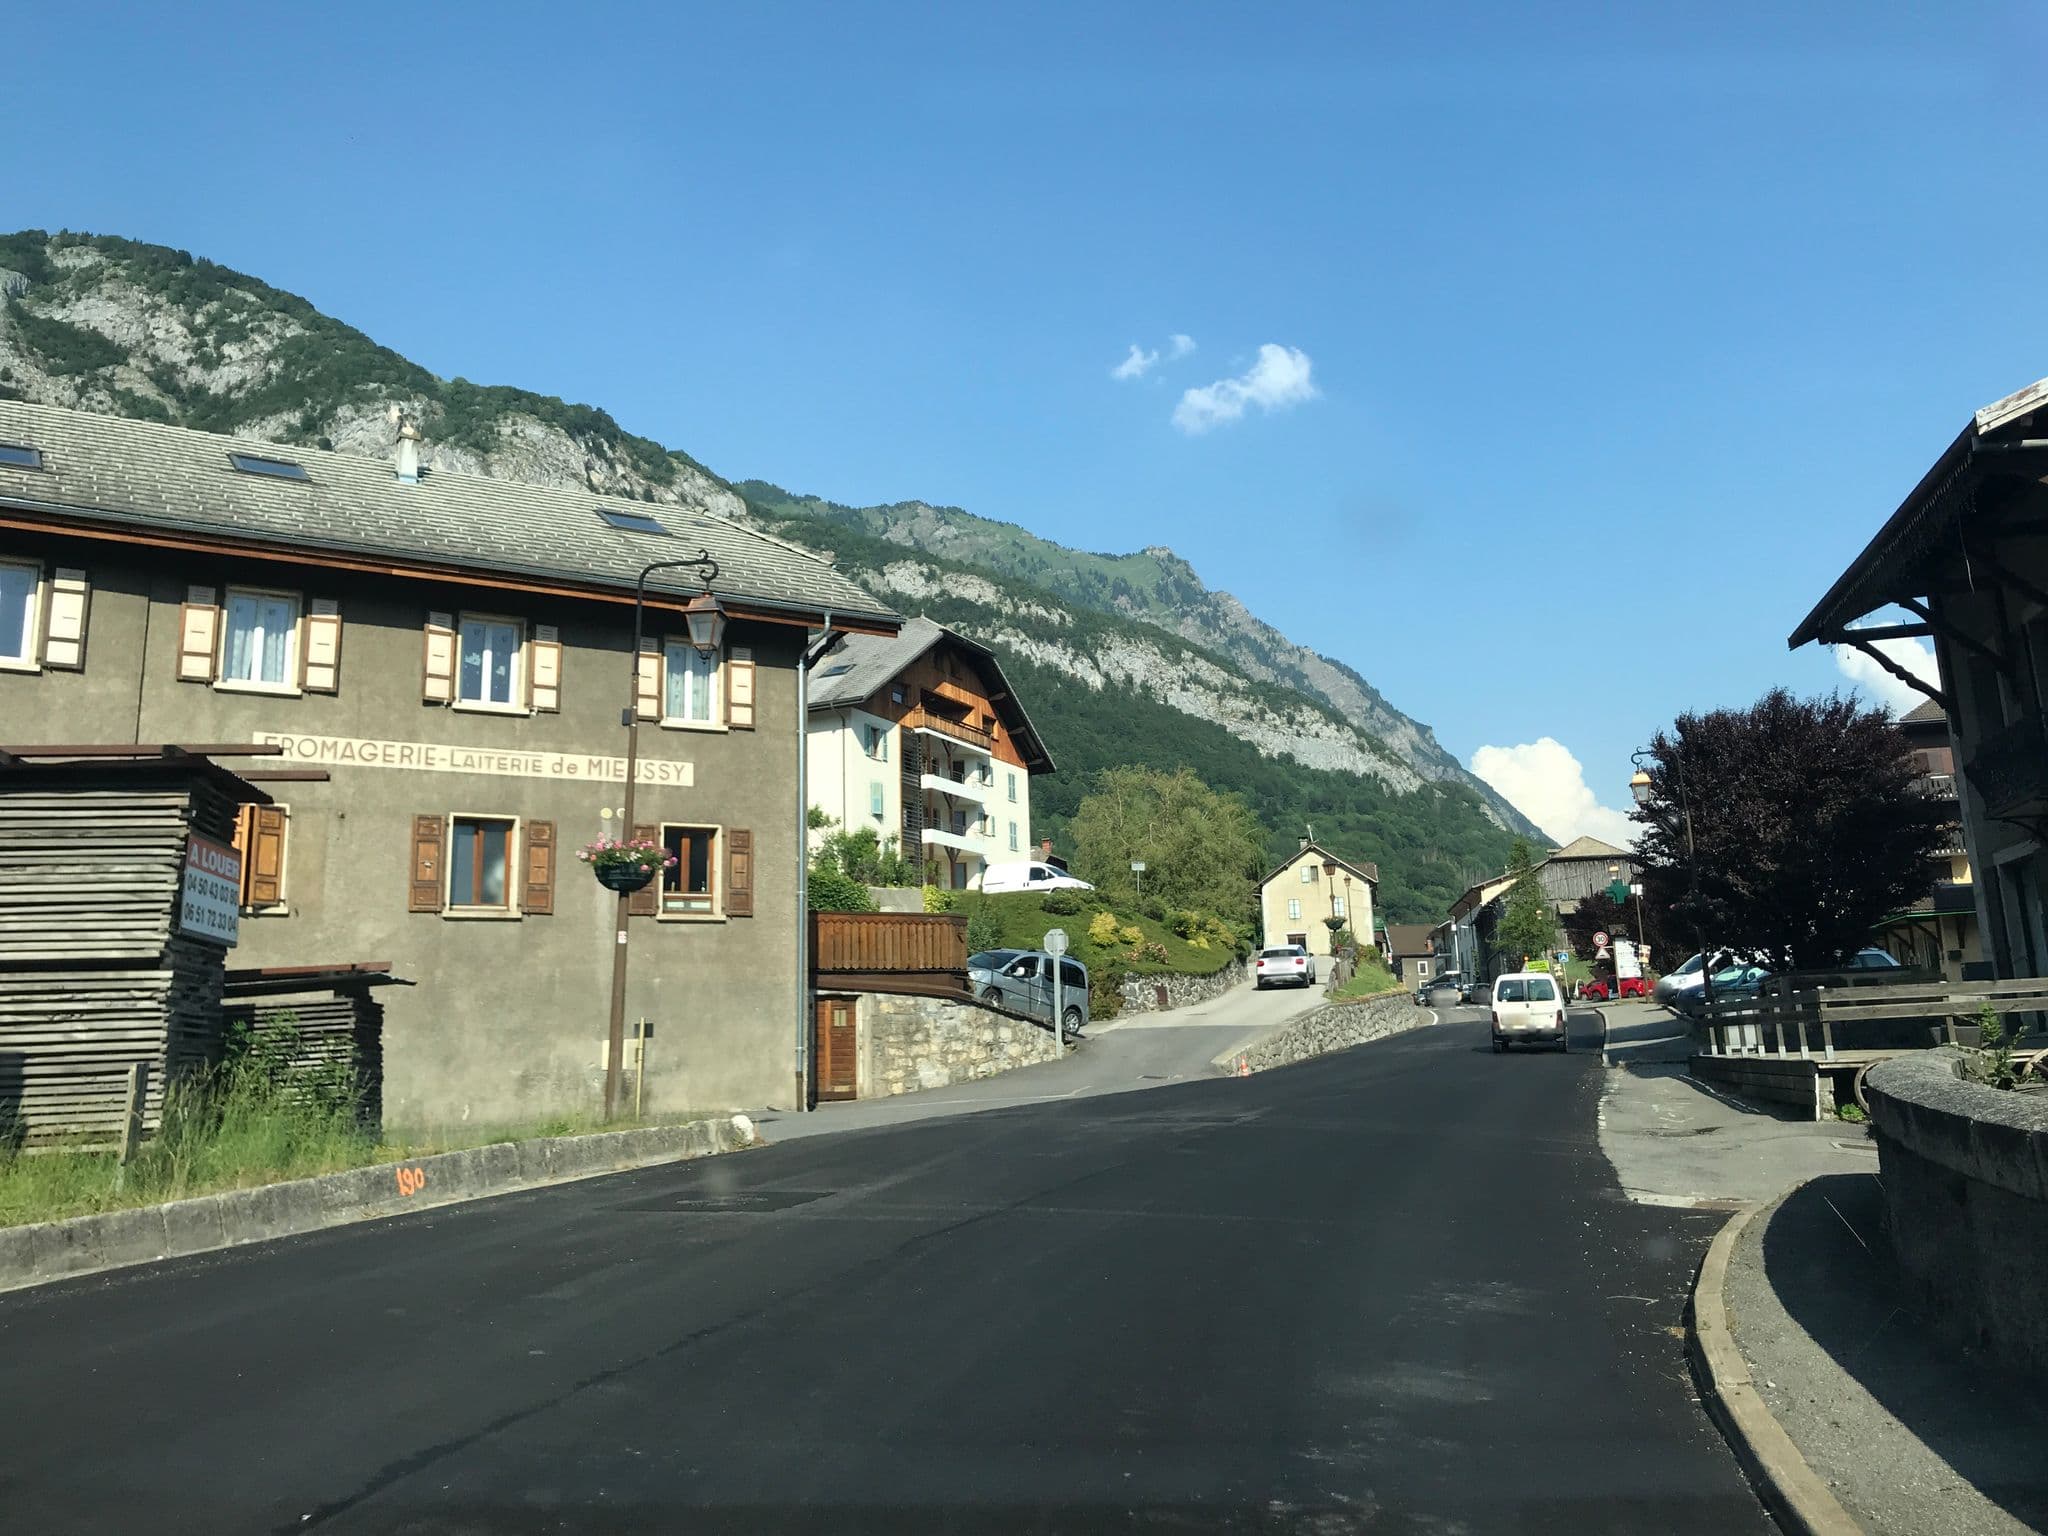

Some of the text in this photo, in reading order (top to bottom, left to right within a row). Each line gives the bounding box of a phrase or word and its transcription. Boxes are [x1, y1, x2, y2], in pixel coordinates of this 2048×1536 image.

[552, 758, 579, 775] de
[190, 842, 240, 880] A LOUER
[396, 1167, 426, 1197] 190
